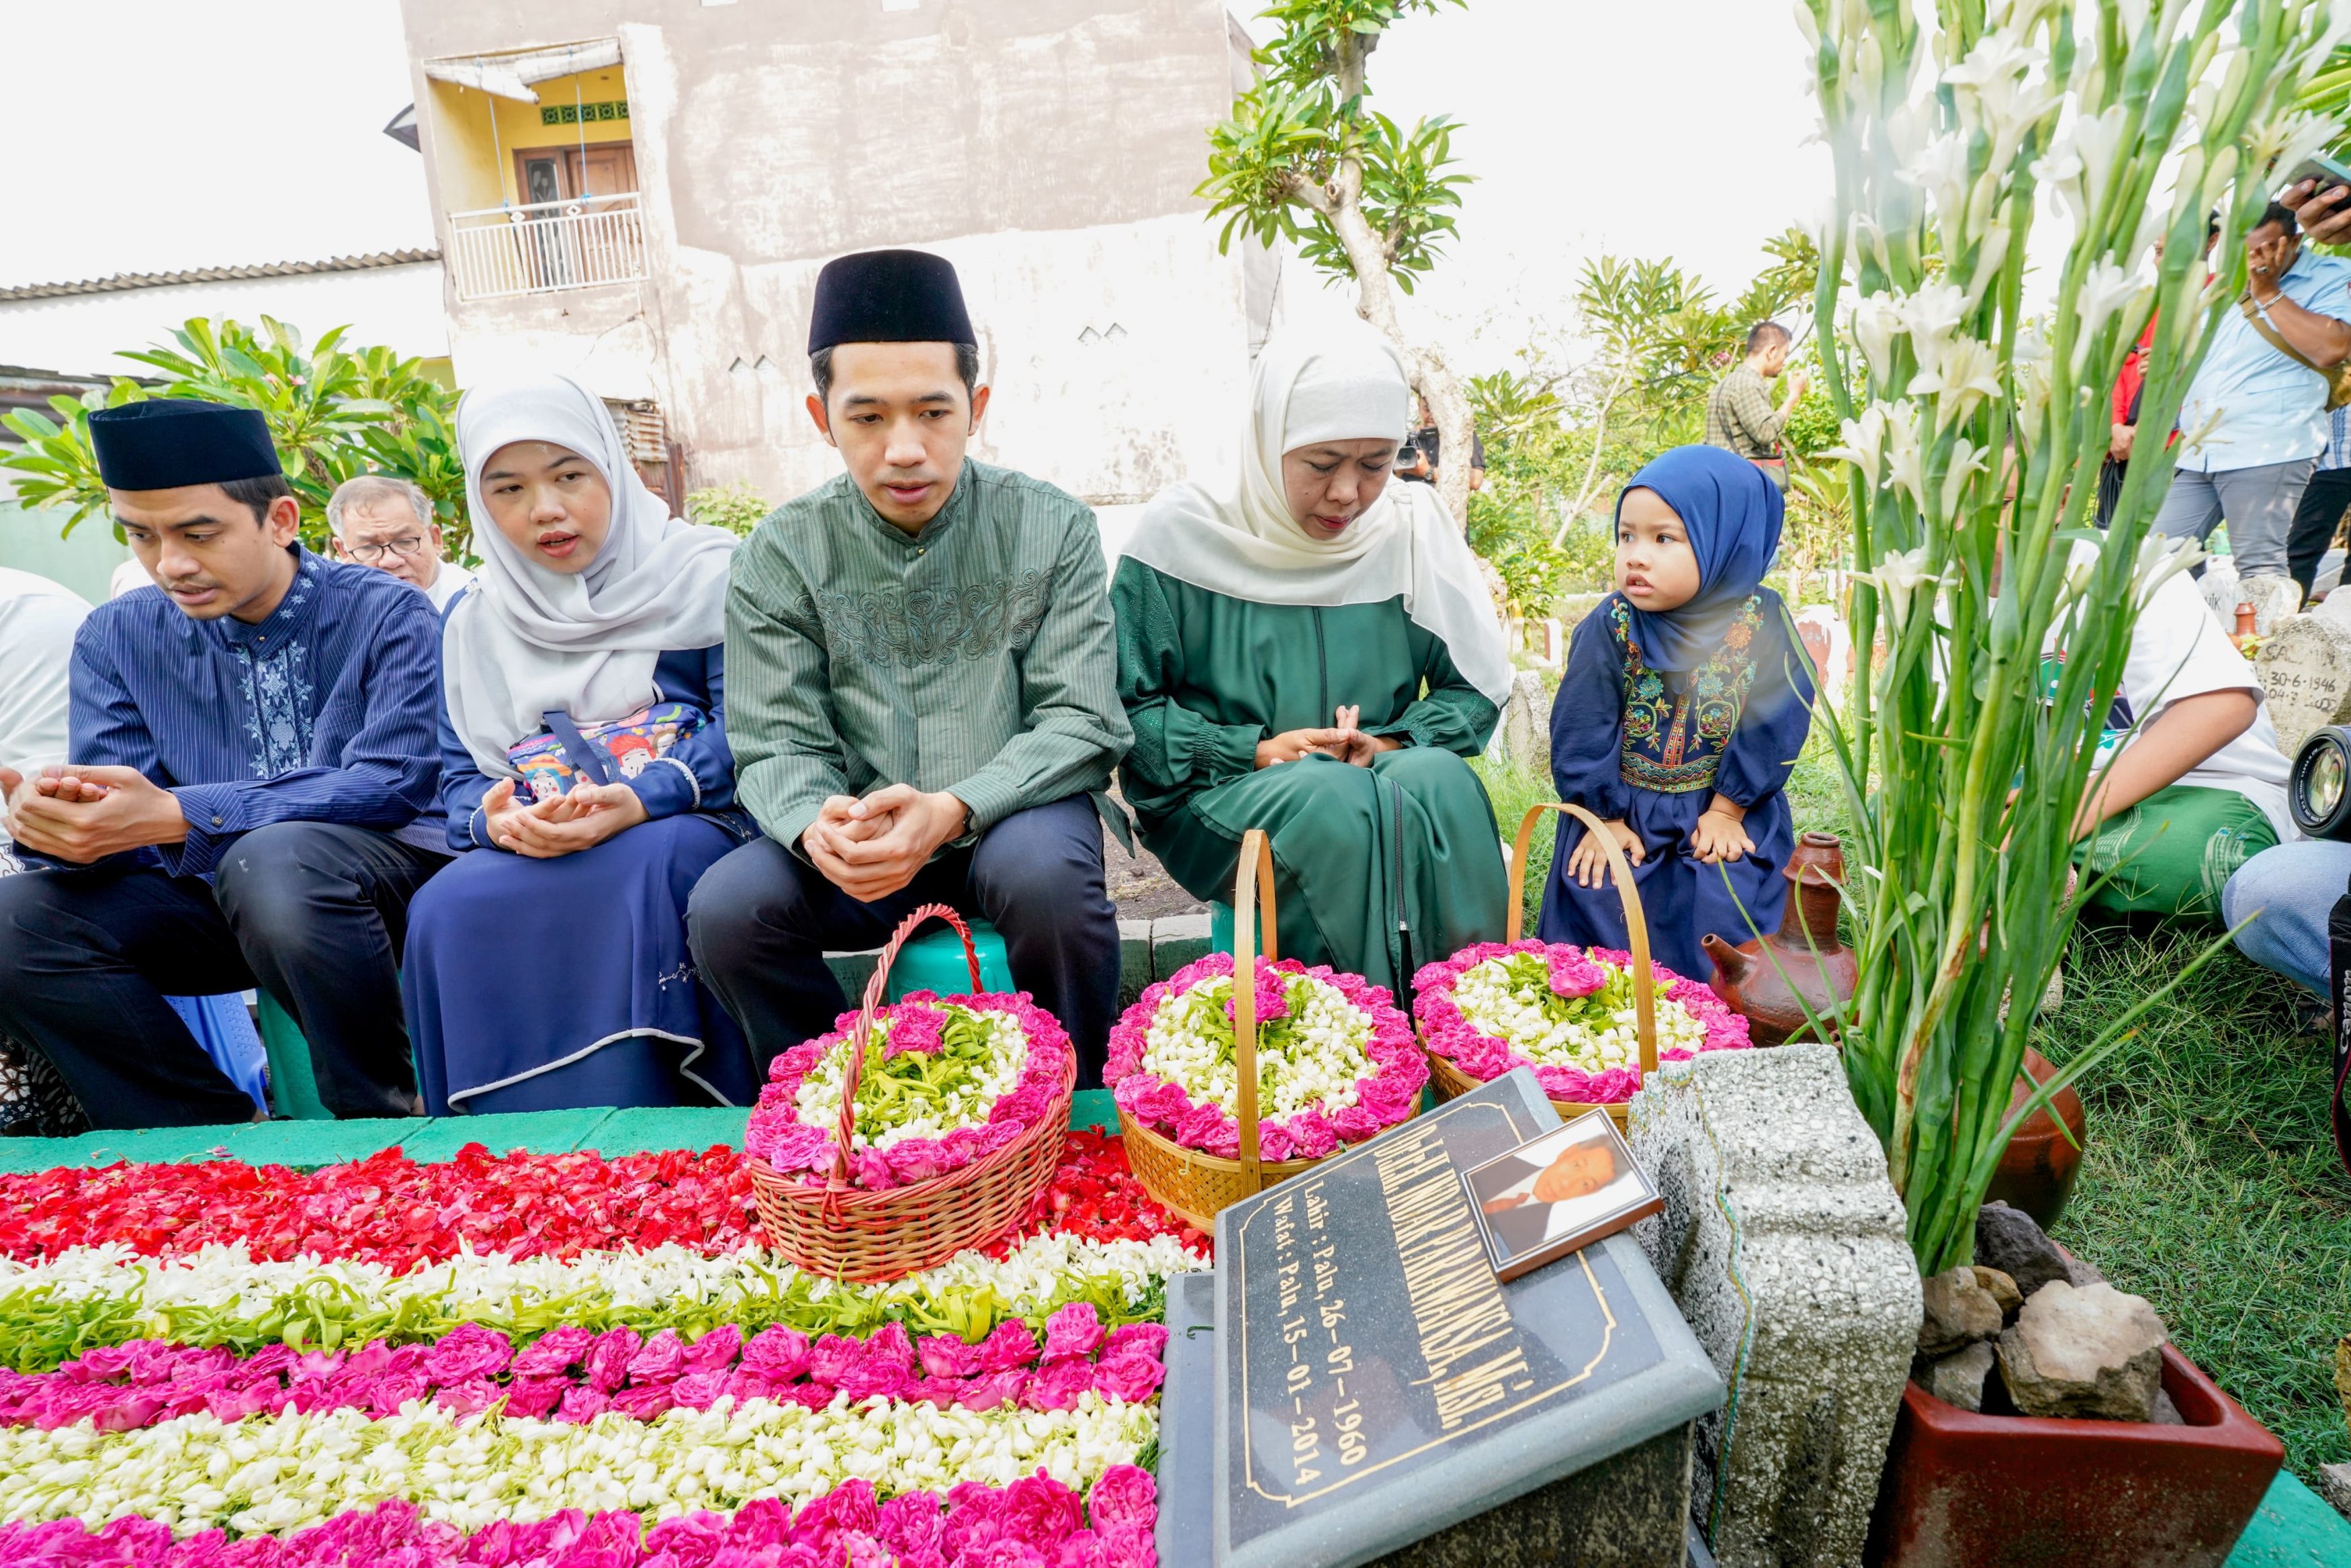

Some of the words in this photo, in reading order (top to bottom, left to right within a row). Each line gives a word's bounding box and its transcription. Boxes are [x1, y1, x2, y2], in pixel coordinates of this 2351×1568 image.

[1274, 1195, 1295, 1250] Wafat
[1304, 1180, 1329, 1230] Lahir
[1386, 1167, 1469, 1250] INDAR
[1278, 1260, 1302, 1316] Palu,
[1313, 1244, 1338, 1300] Palu,
[1399, 1220, 1513, 1385] PARAWANSA,
